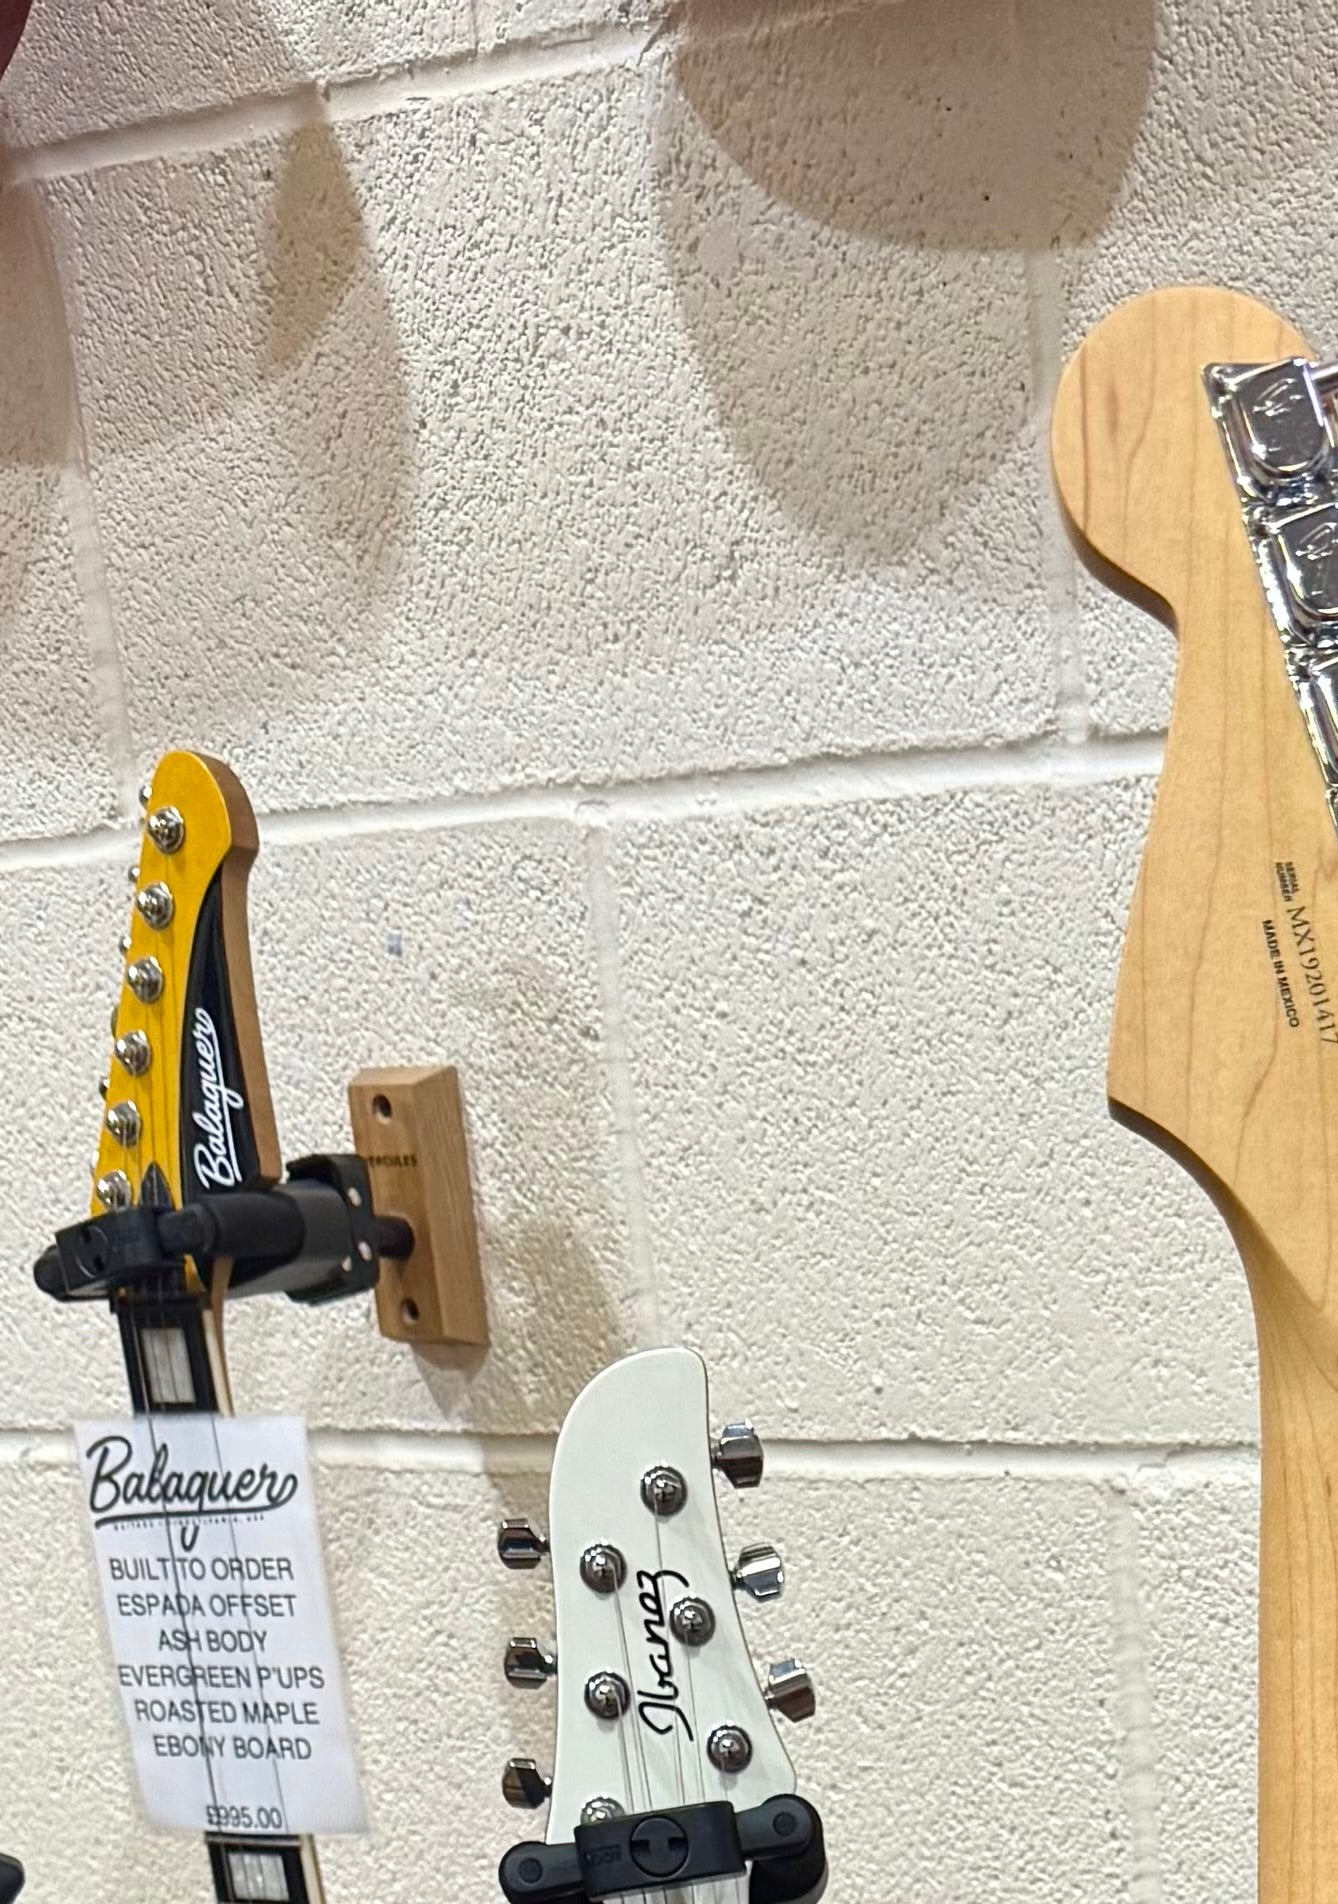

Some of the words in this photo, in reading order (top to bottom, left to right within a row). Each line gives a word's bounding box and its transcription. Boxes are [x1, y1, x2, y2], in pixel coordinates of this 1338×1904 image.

[1263, 919, 1281, 960] MADE
[1273, 960, 1285, 975] IN
[1277, 976, 1300, 1028] MEXICO
[193, 1007, 243, 1189] Balaguer
[86, 1435, 298, 1553] Balaguer
[109, 1557, 171, 1580] BUILT
[175, 1557, 206, 1580] TO
[211, 1557, 294, 1581] ORDER
[117, 1594, 205, 1616] ESPADA
[209, 1594, 296, 1617] OFFSET
[159, 1629, 202, 1651] ASH
[206, 1629, 267, 1652] BODY
[118, 1665, 251, 1688] EVERGREEN
[134, 1699, 237, 1723] ROASTED
[243, 1702, 320, 1725] MAPLE
[153, 1735, 225, 1758] EBONY
[233, 1737, 312, 1760] BOARD
